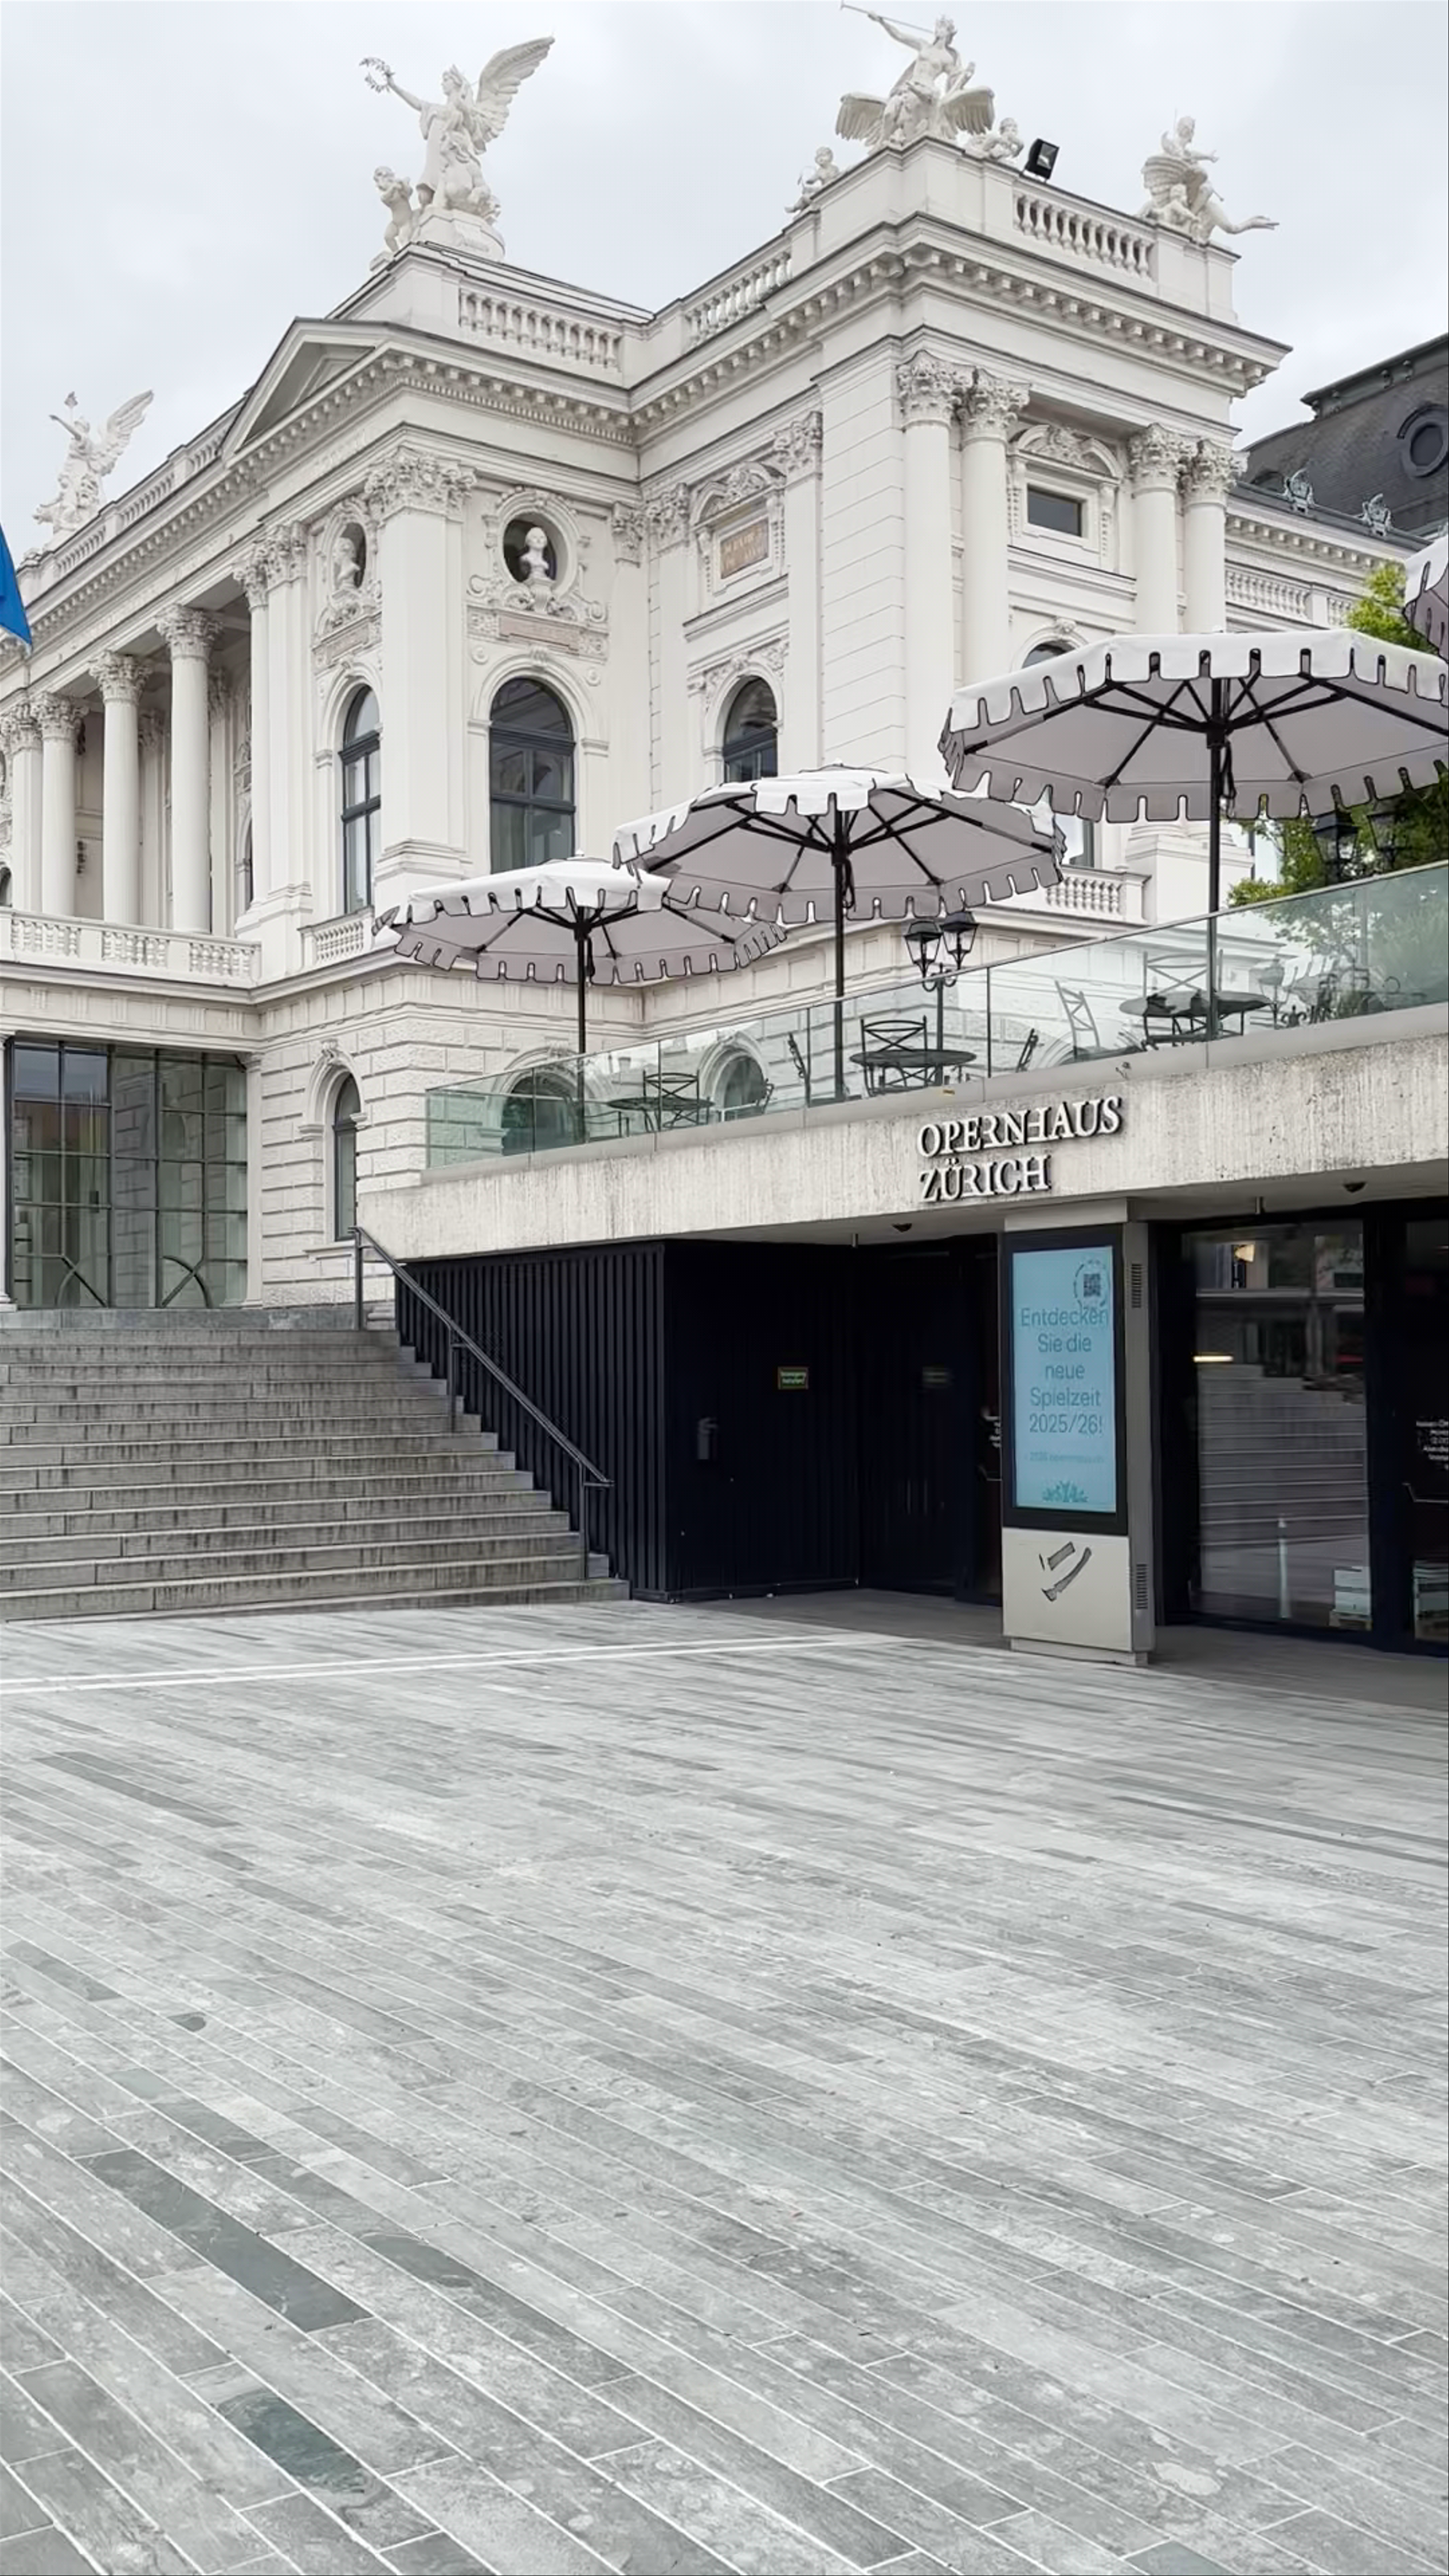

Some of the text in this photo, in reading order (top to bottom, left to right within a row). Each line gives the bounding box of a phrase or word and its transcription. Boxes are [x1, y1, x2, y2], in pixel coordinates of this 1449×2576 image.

[917, 1096, 1122, 1157] OPERNHAUS
[920, 1155, 1052, 1201] ZÜRICH
[1021, 1307, 1108, 1327] Entdecken
[1038, 1332, 1091, 1352] Sie die
[1046, 1364, 1085, 1380] neue
[1030, 1387, 1100, 1411] Spielzeit
[1029, 1413, 1103, 1434] 2025/26!
